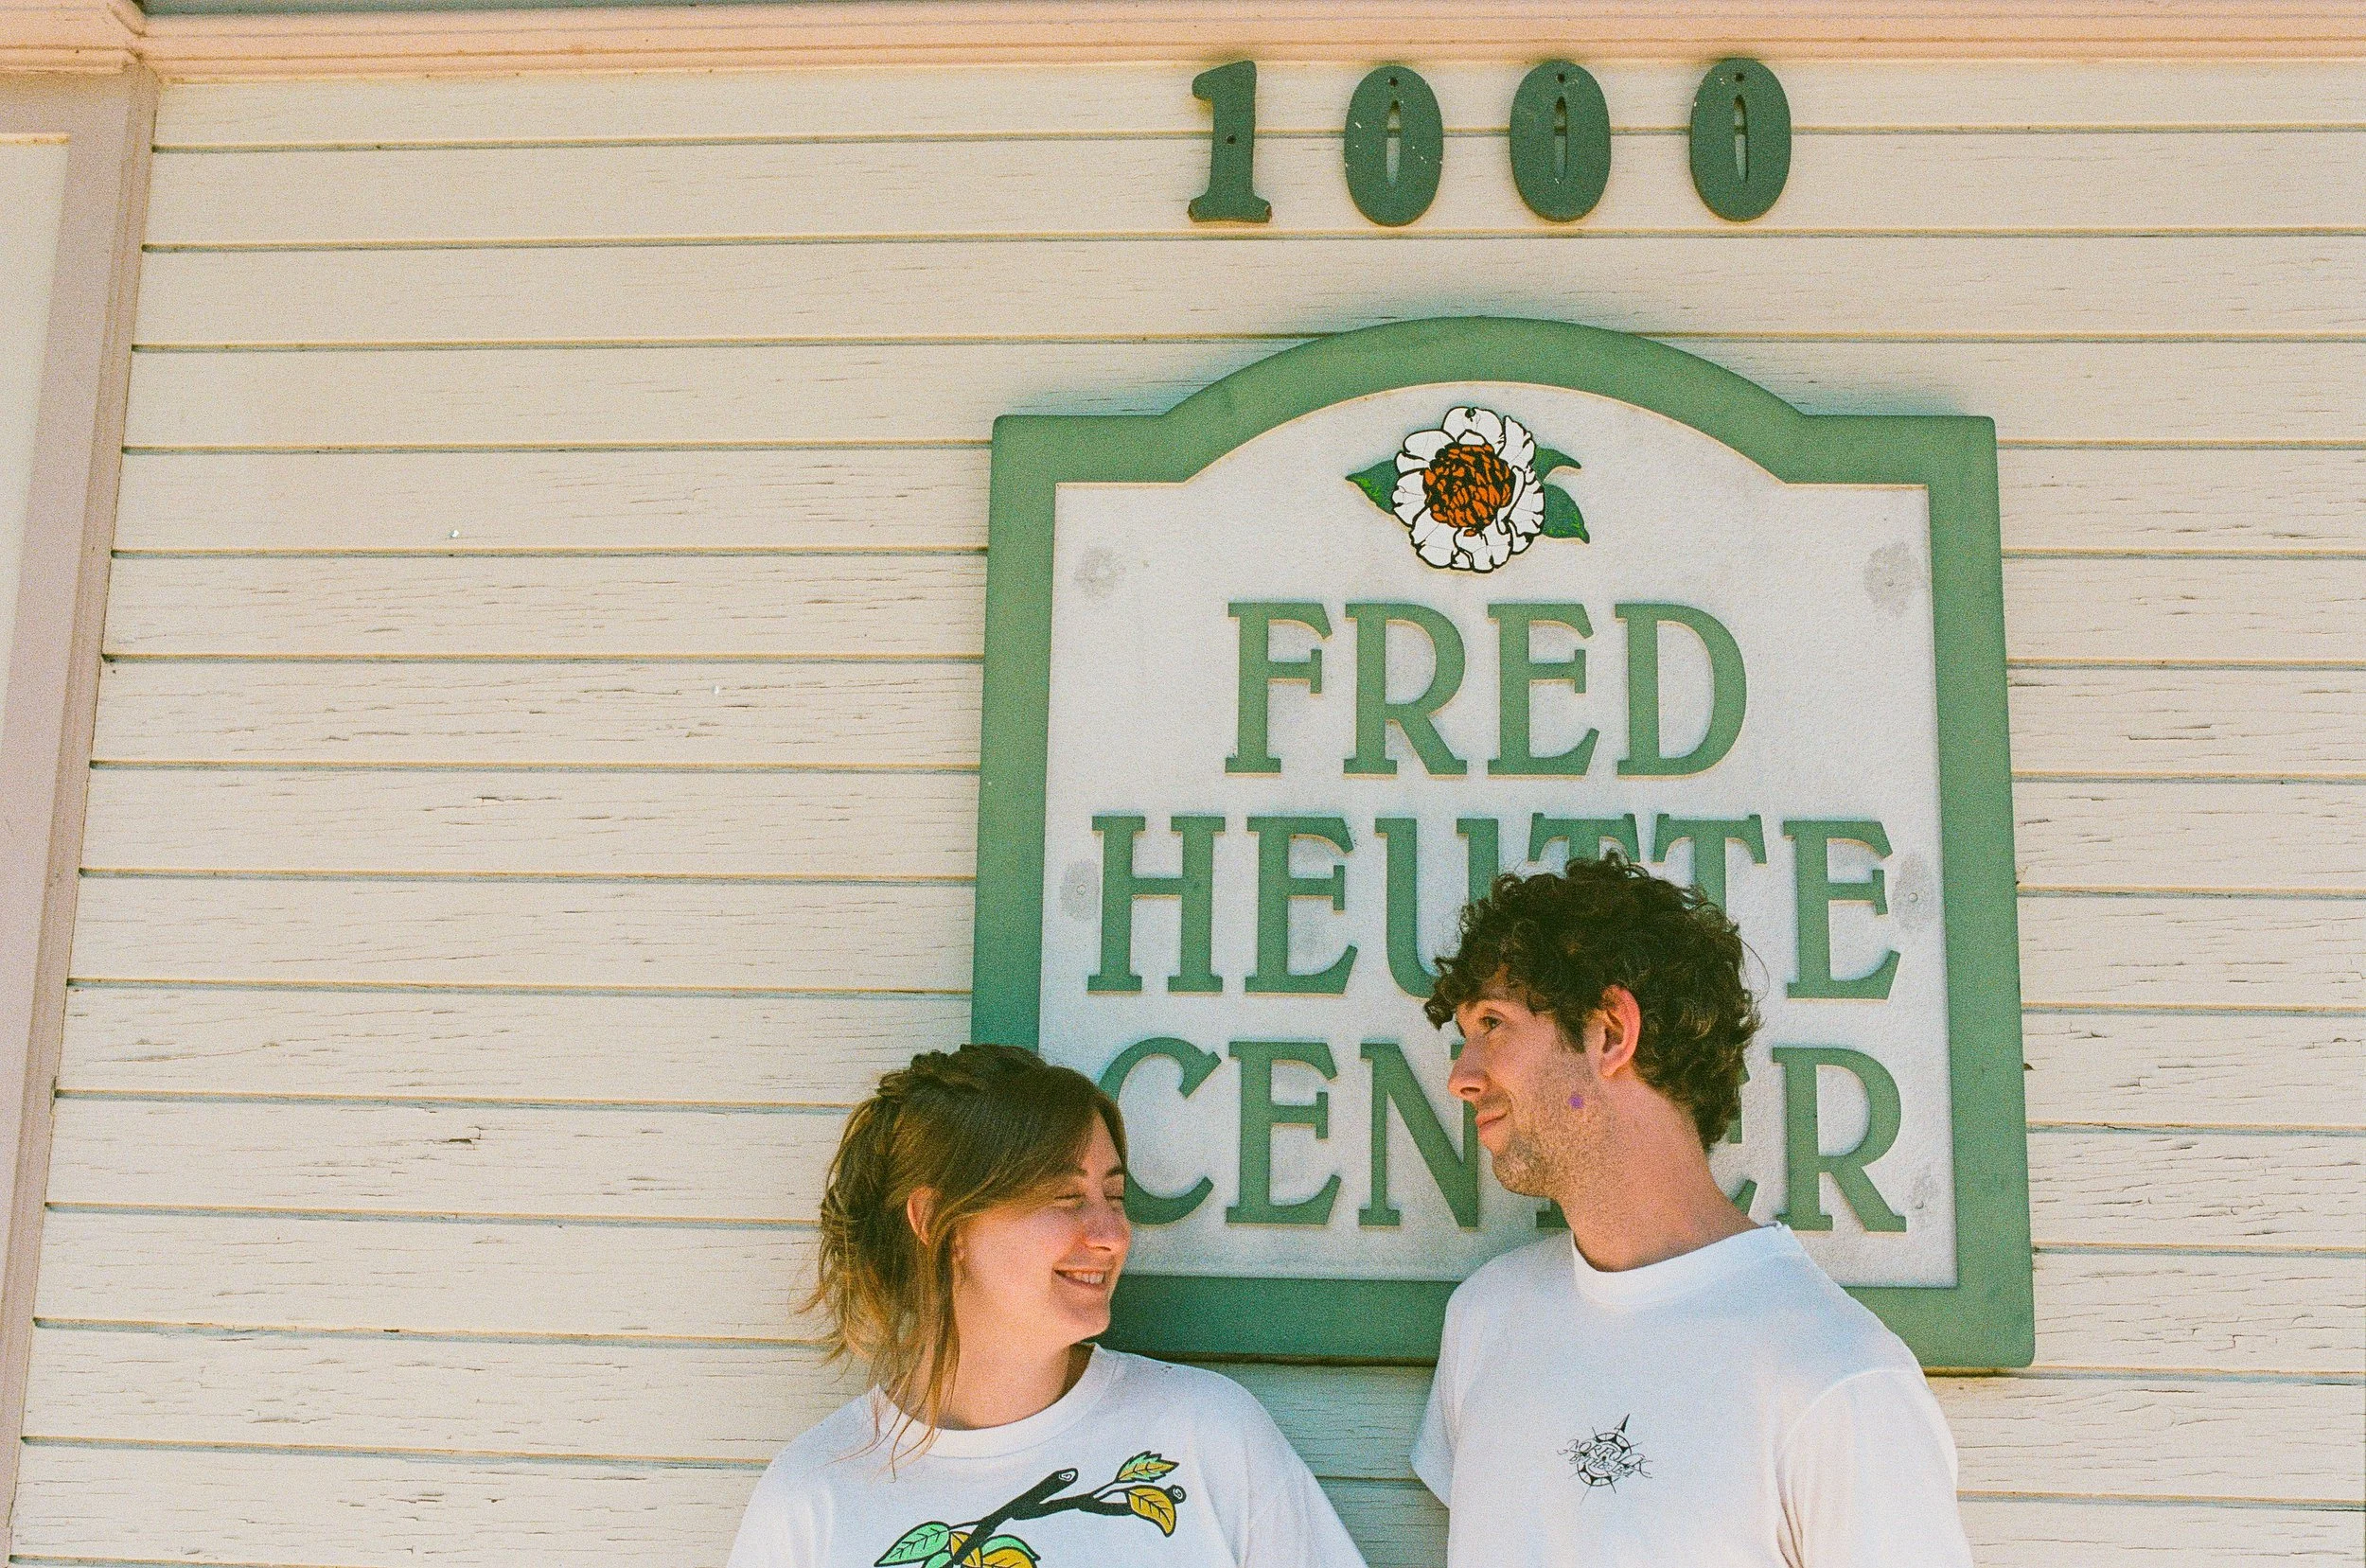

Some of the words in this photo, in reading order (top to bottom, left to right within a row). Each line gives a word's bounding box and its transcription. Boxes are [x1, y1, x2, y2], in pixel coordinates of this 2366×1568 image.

[1187, 60, 1792, 226] 1000
[1225, 602, 1747, 777] FRED
[1098, 1036, 1907, 1233] CENR
